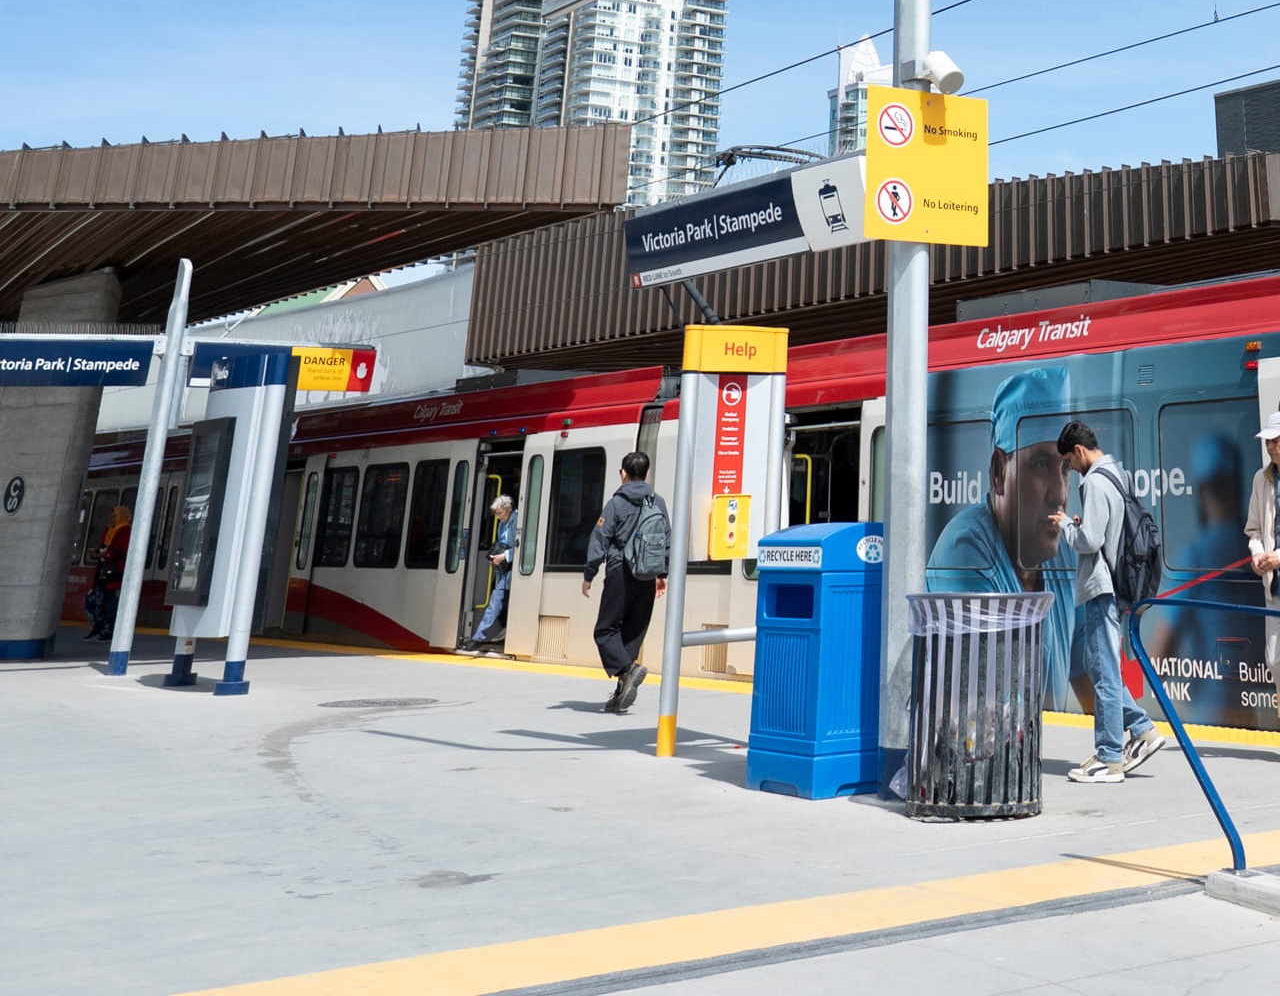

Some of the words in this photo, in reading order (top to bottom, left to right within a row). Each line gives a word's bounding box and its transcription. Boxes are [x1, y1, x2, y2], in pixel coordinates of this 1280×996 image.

[924, 124, 937, 135] No
[938, 125, 978, 141] Smoking
[923, 199, 936, 209] No
[938, 200, 979, 215] Loitering
[642, 227, 685, 252] Victoria
[687, 219, 713, 244] Park
[719, 203, 782, 235] Stampede
[643, 273, 653, 282] RED
[652, 271, 663, 281] LINE
[663, 270, 668, 279] to
[668, 268, 682, 278] South
[977, 325, 1035, 353] Calgary
[1038, 314, 1092, 342] Transit
[724, 342, 757, 360] Help
[35, 358, 65, 370] Park
[73, 357, 140, 373] Stampede
[303, 356, 346, 366] DANGER
[413, 403, 440, 422] Calgary
[439, 399, 464, 416] Transit
[929, 471, 982, 504] Build
[766, 550, 794, 562] RECYCLE
[795, 550, 812, 562] HERE
[1150, 657, 1223, 680] NATIONAL
[1152, 681, 1191, 701] ANK
